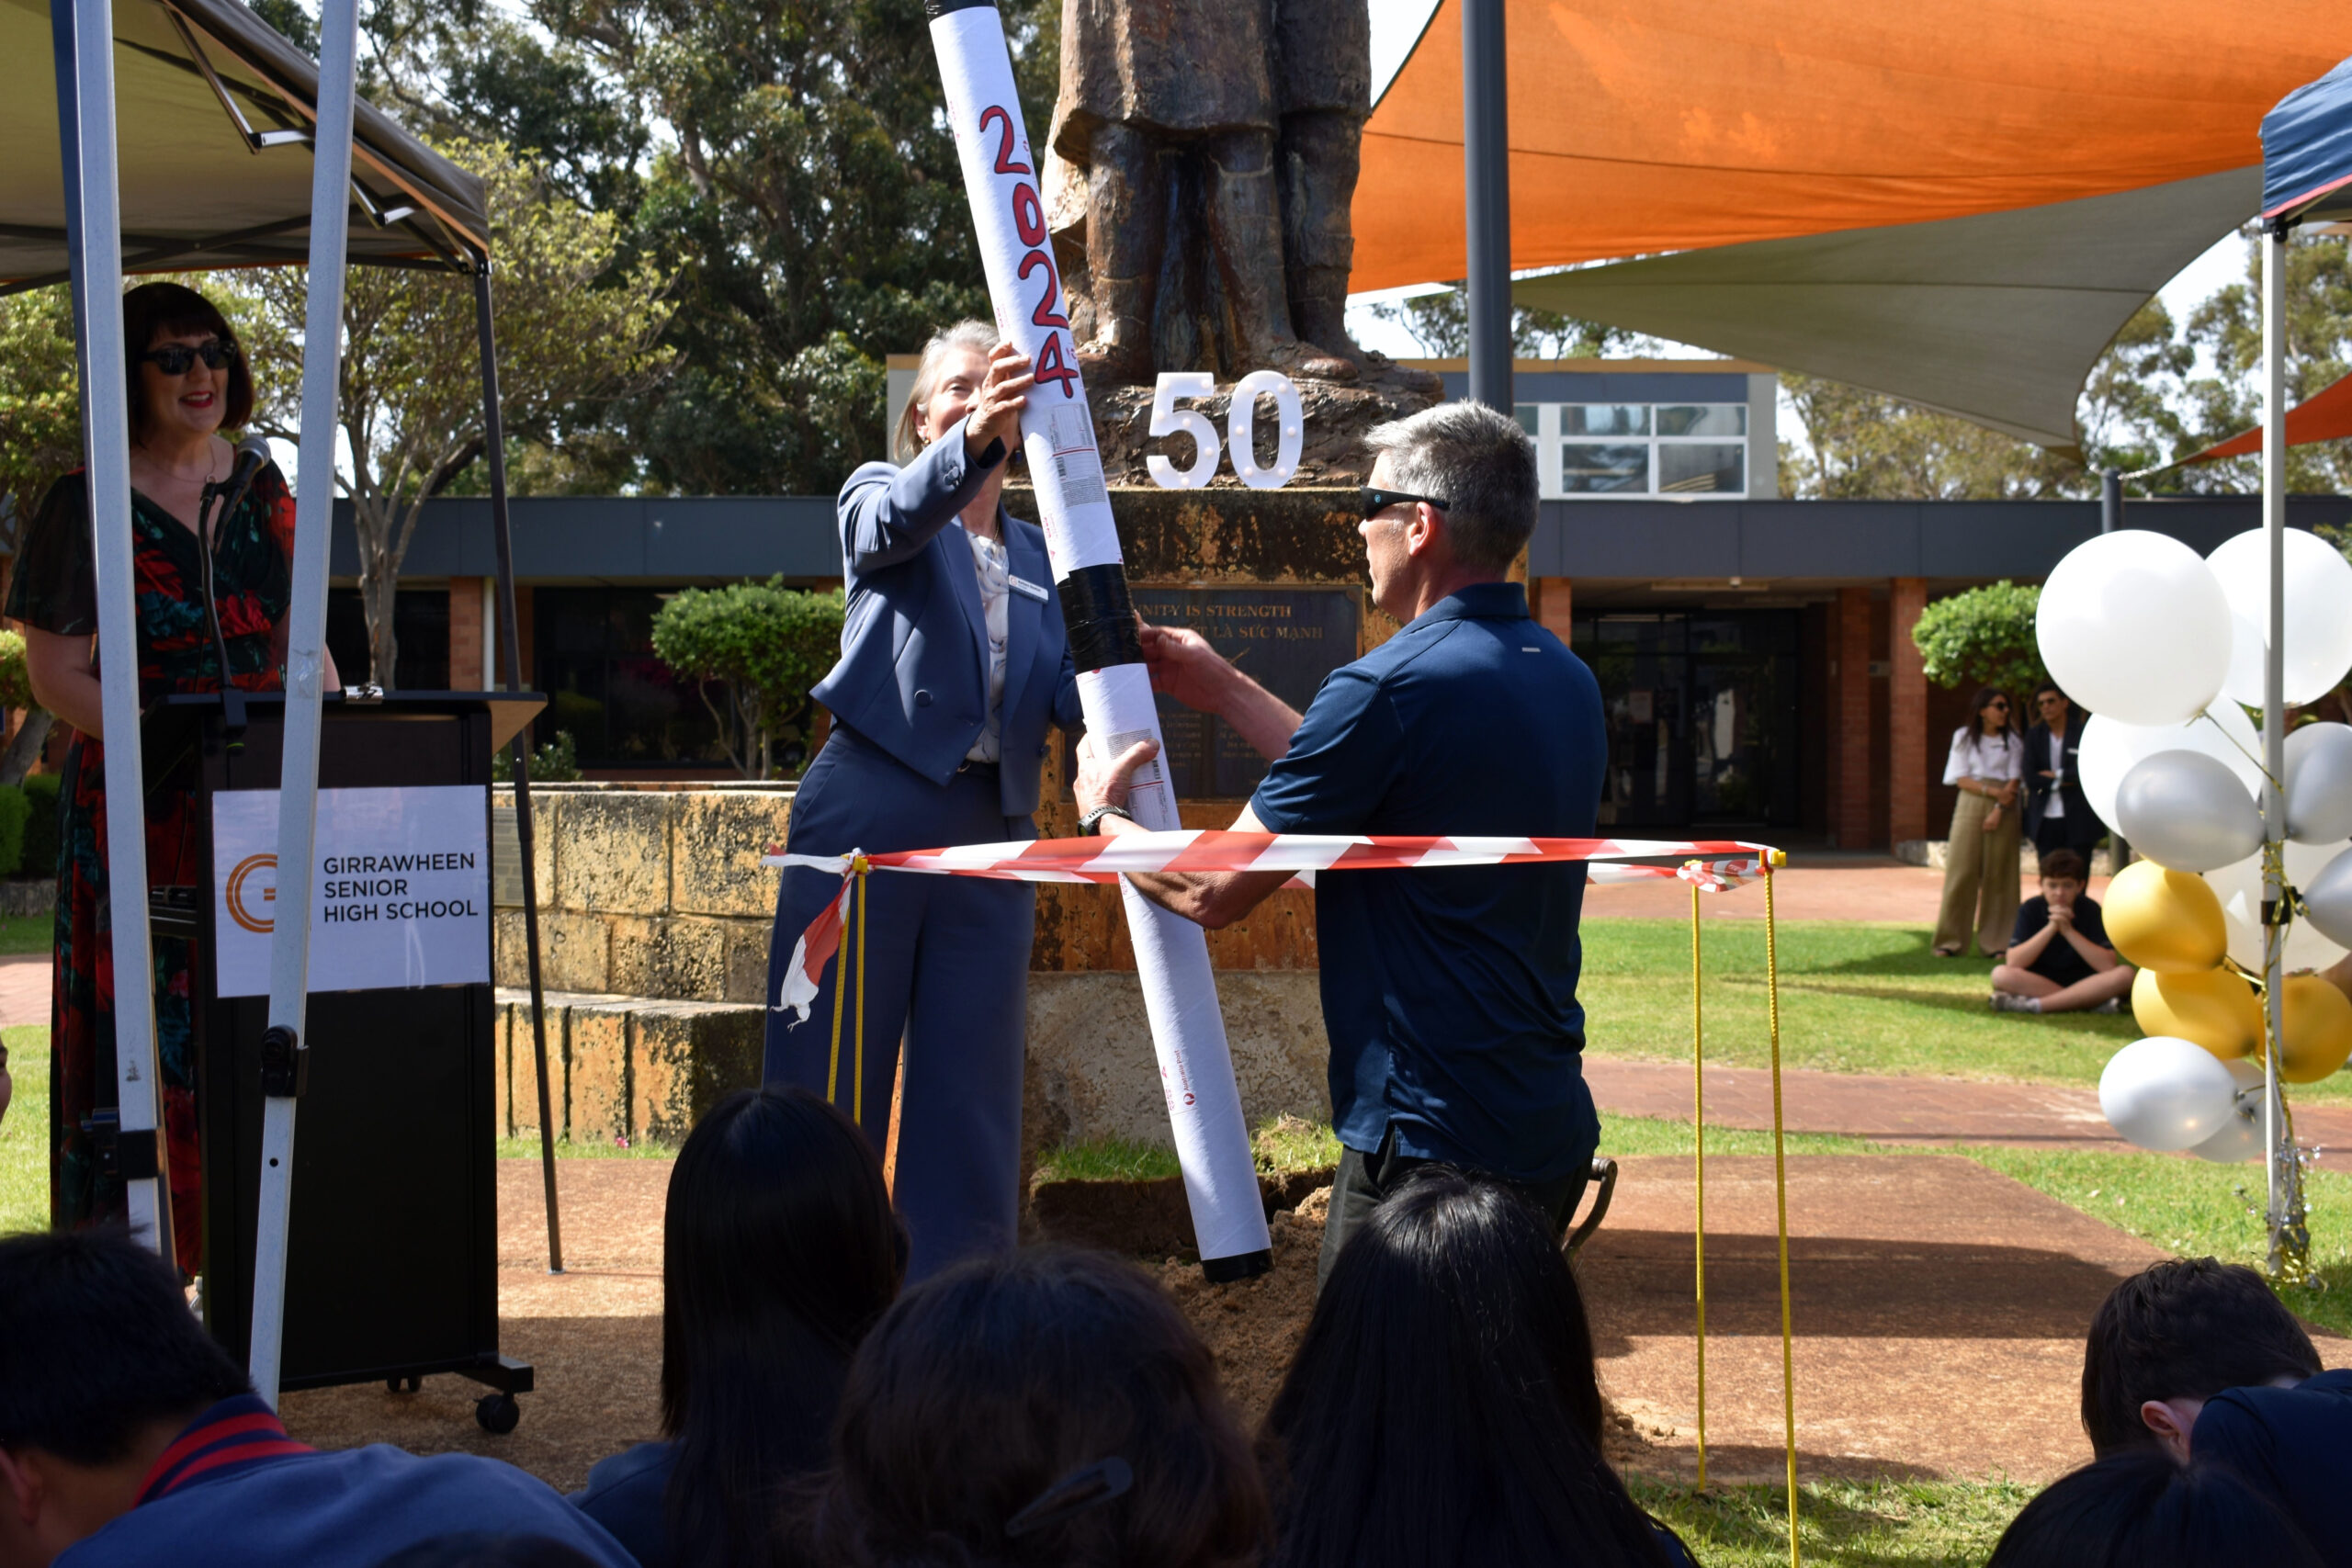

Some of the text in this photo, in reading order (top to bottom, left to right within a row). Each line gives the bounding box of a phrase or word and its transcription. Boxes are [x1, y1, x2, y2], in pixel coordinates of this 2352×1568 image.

[980, 106, 1078, 398] 2024
[1146, 369, 1305, 490] 50
[1185, 604, 1201, 616] IS
[1205, 604, 1293, 617] STRENGTH
[323, 852, 475, 874] GIRRAWHEEN
[323, 878, 408, 899] SENIOR
[323, 899, 479, 923] HIGH SCHOOL
[1179, 1065, 1190, 1090] Australia
